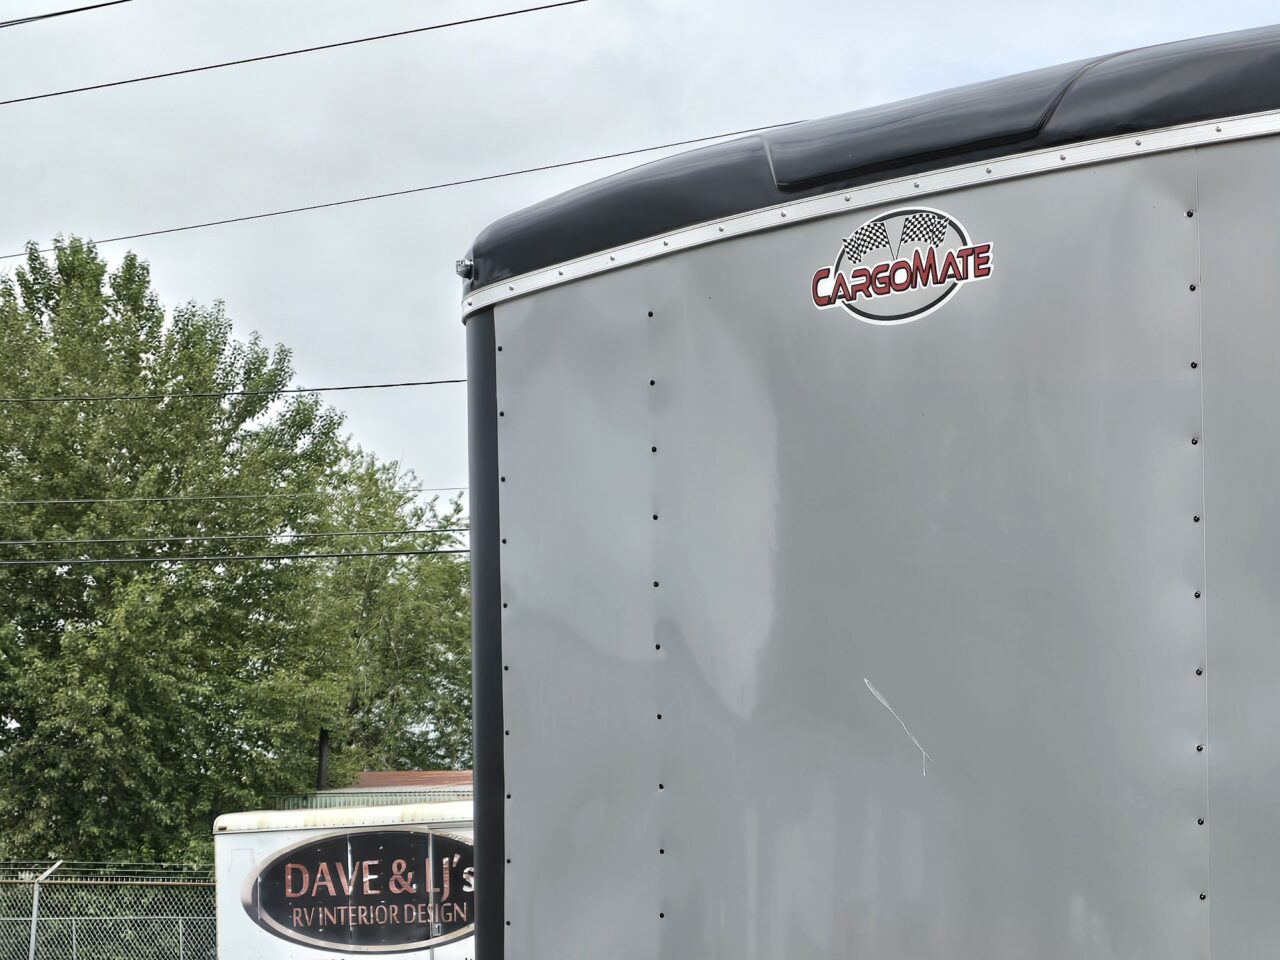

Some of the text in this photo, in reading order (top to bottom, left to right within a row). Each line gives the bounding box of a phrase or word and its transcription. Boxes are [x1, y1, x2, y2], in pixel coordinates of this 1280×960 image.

[811, 245, 992, 307] CARGOMATE
[284, 860, 381, 898] DAVE
[388, 858, 417, 895] &
[292, 902, 467, 928] RV INTERIOR DESIGN
